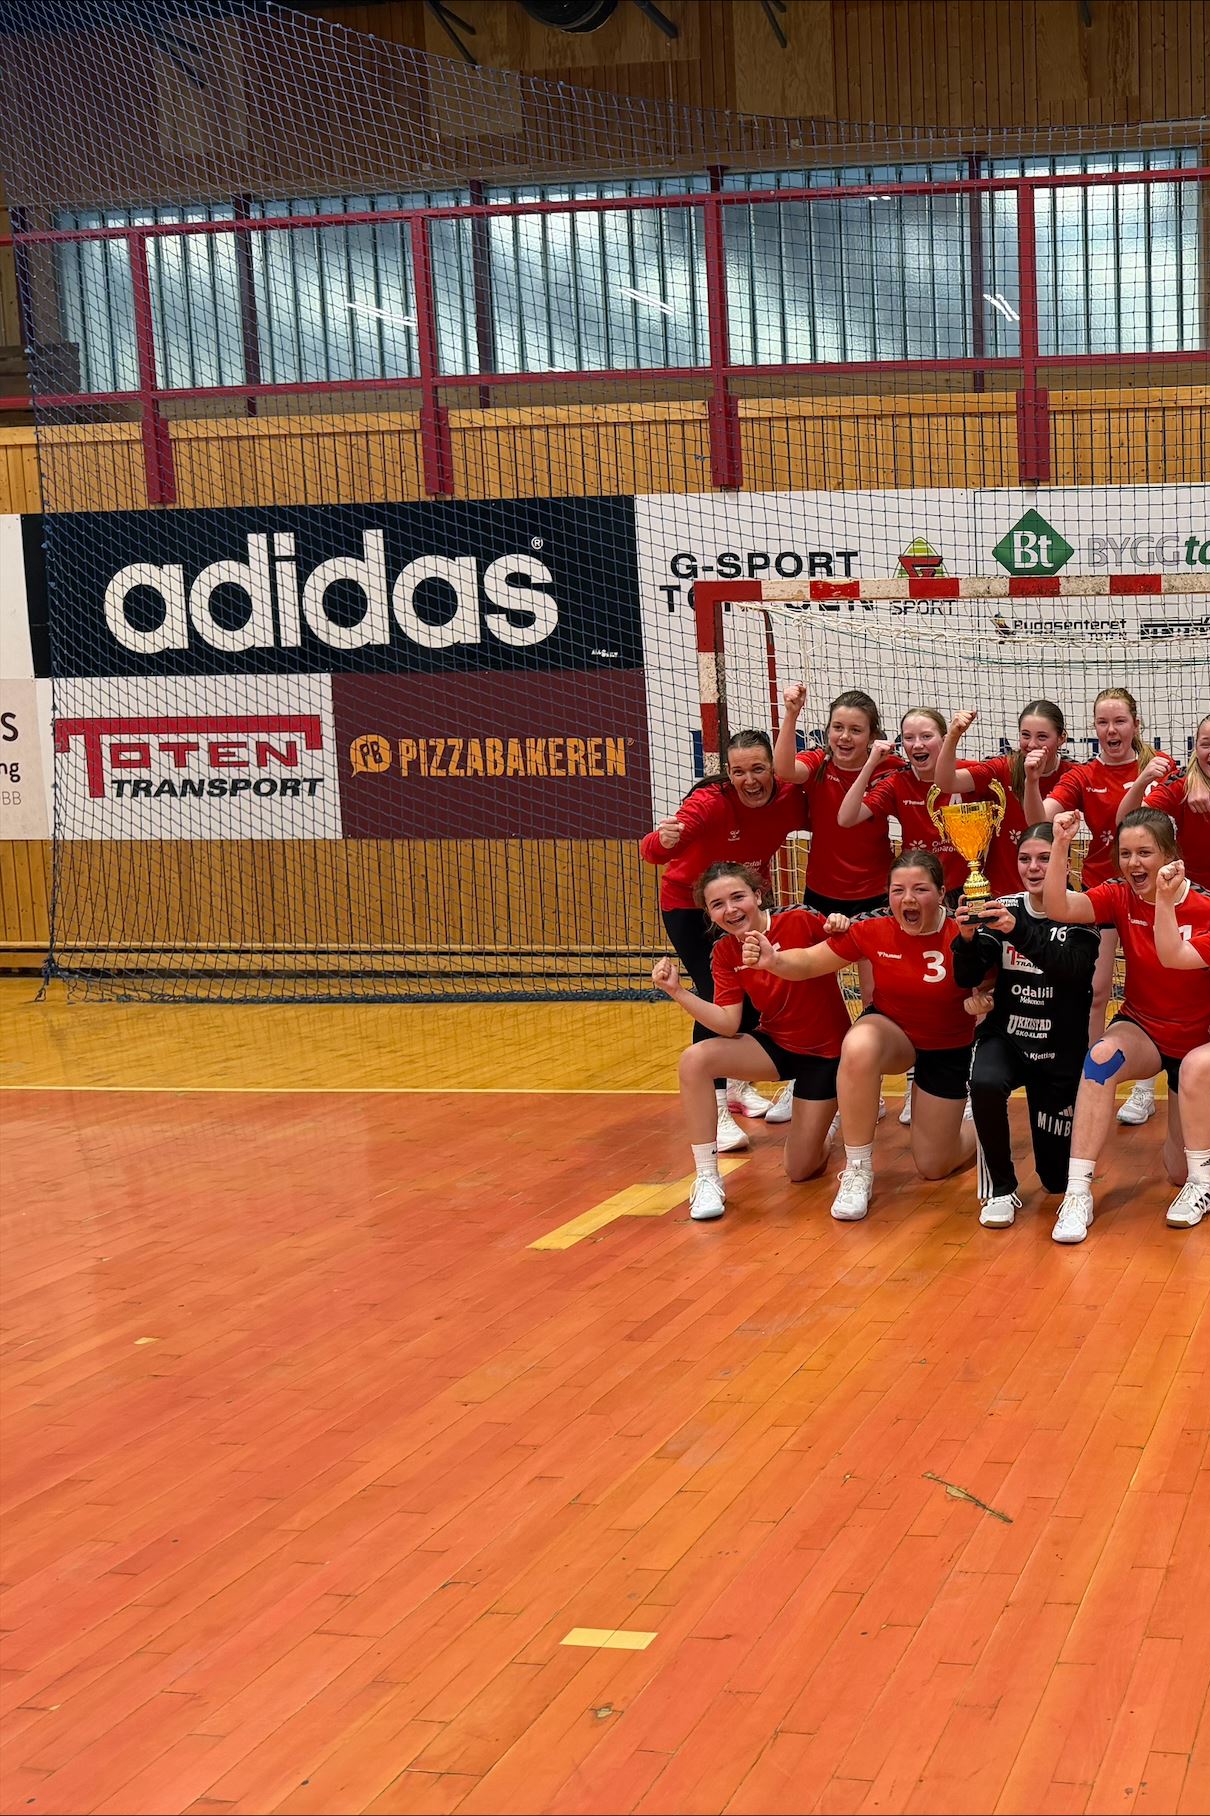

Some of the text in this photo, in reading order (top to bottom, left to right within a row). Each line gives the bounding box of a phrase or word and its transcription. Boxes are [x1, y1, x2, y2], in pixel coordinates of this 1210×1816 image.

[670, 551, 859, 579] G-SPORT
[1013, 530, 1055, 568] Bt
[104, 528, 561, 654] adidas
[891, 599, 956, 615] SPORT
[54, 715, 323, 798] TOTEN
[398, 737, 627, 777] PIZZABAKEREN
[111, 777, 324, 799] TRANSPORT
[1050, 926, 1068, 943] 16
[922, 950, 947, 984] 3
